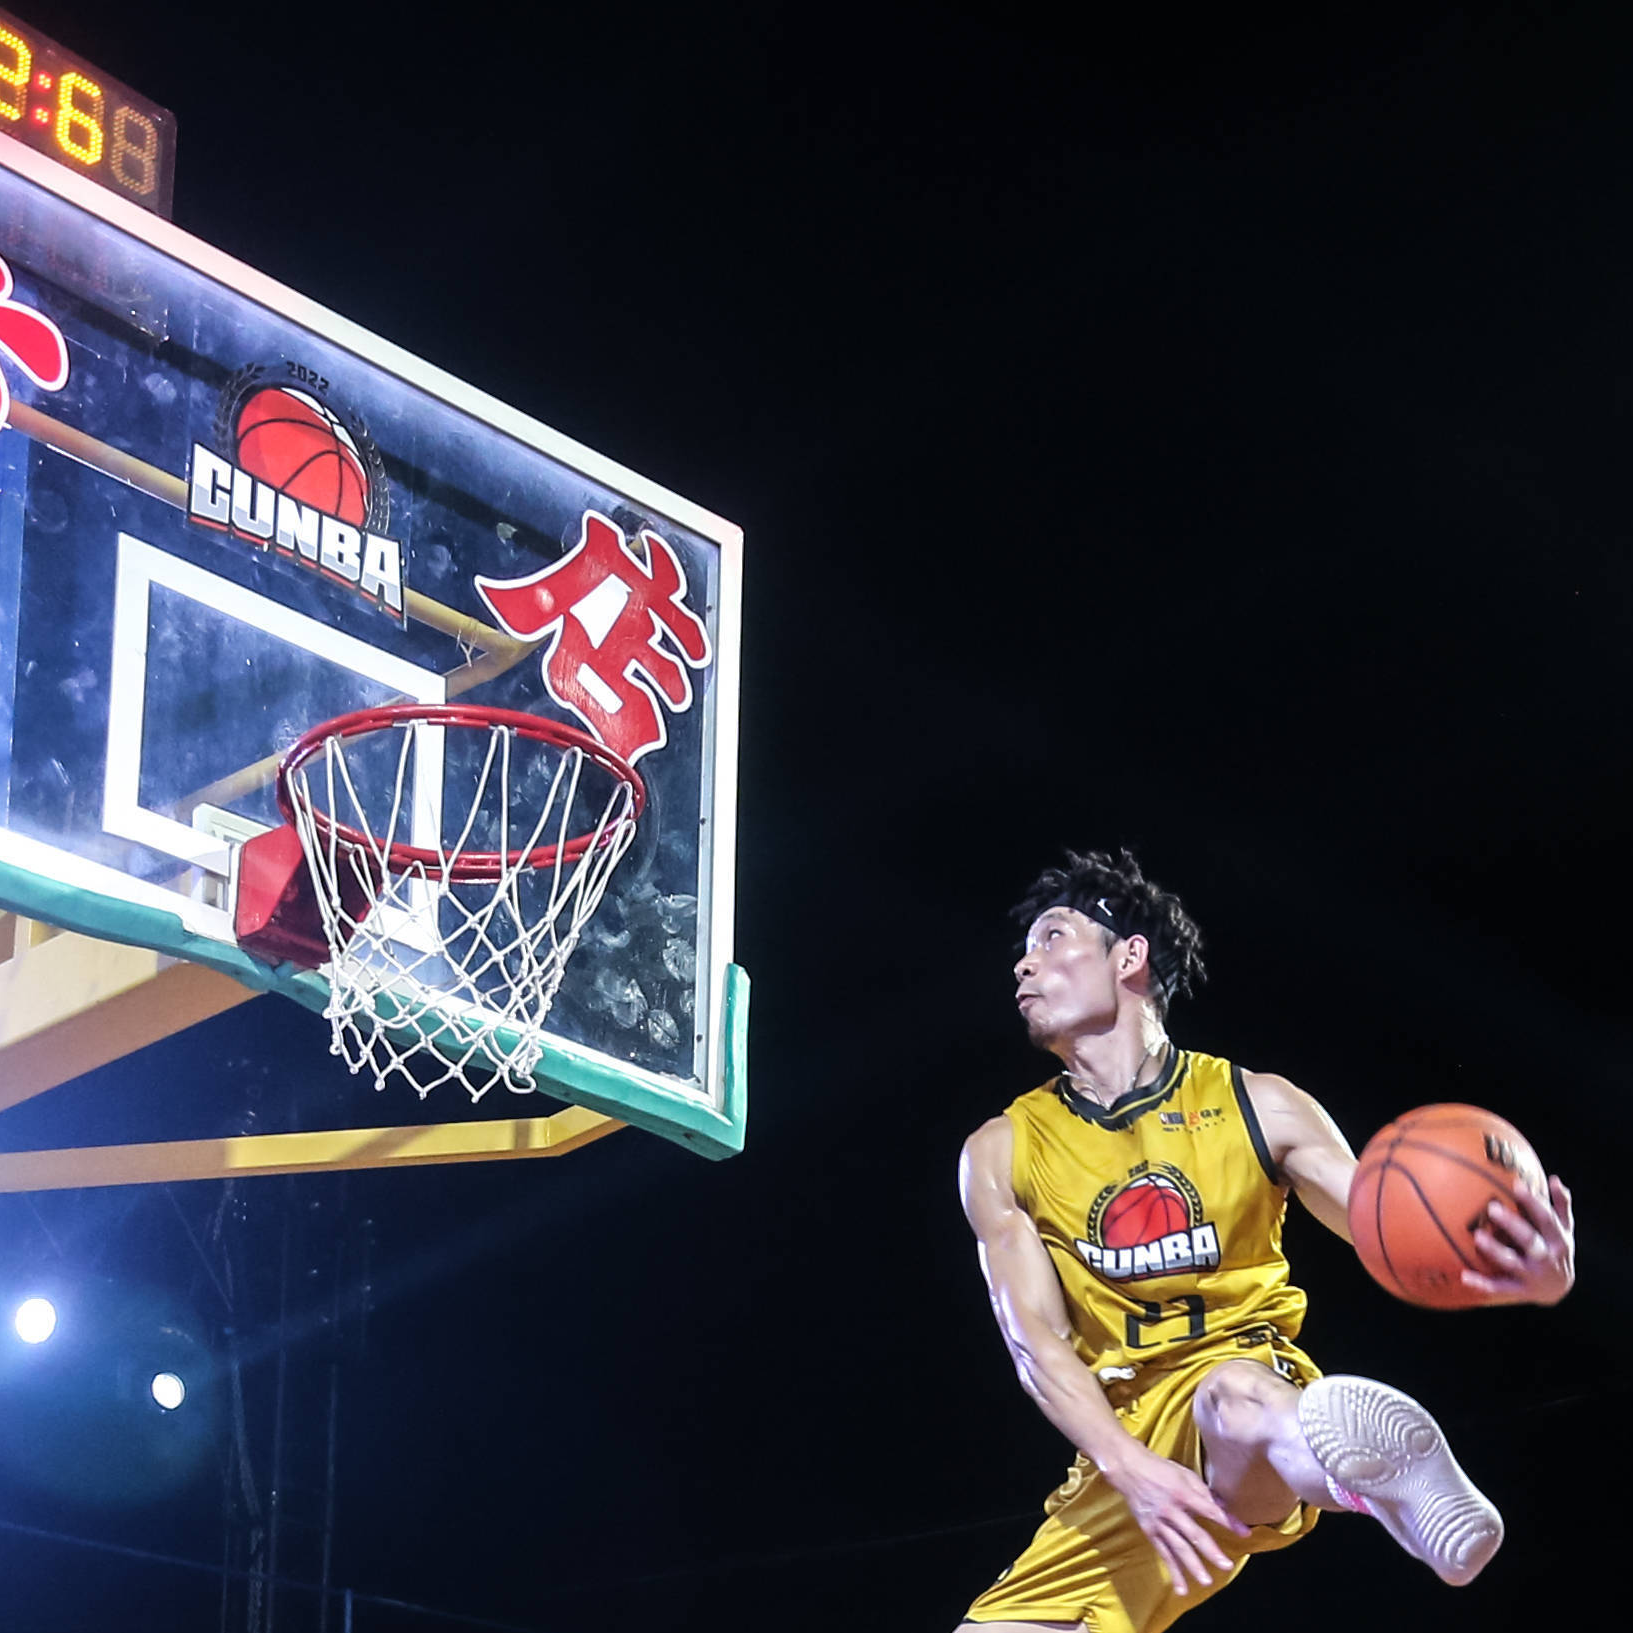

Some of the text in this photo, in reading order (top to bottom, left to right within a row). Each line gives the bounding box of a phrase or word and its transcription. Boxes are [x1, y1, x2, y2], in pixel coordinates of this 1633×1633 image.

[286, 360, 330, 395] 2022
[190, 443, 403, 613] CUNBA
[1075, 1223, 1220, 1277] CUNBA
